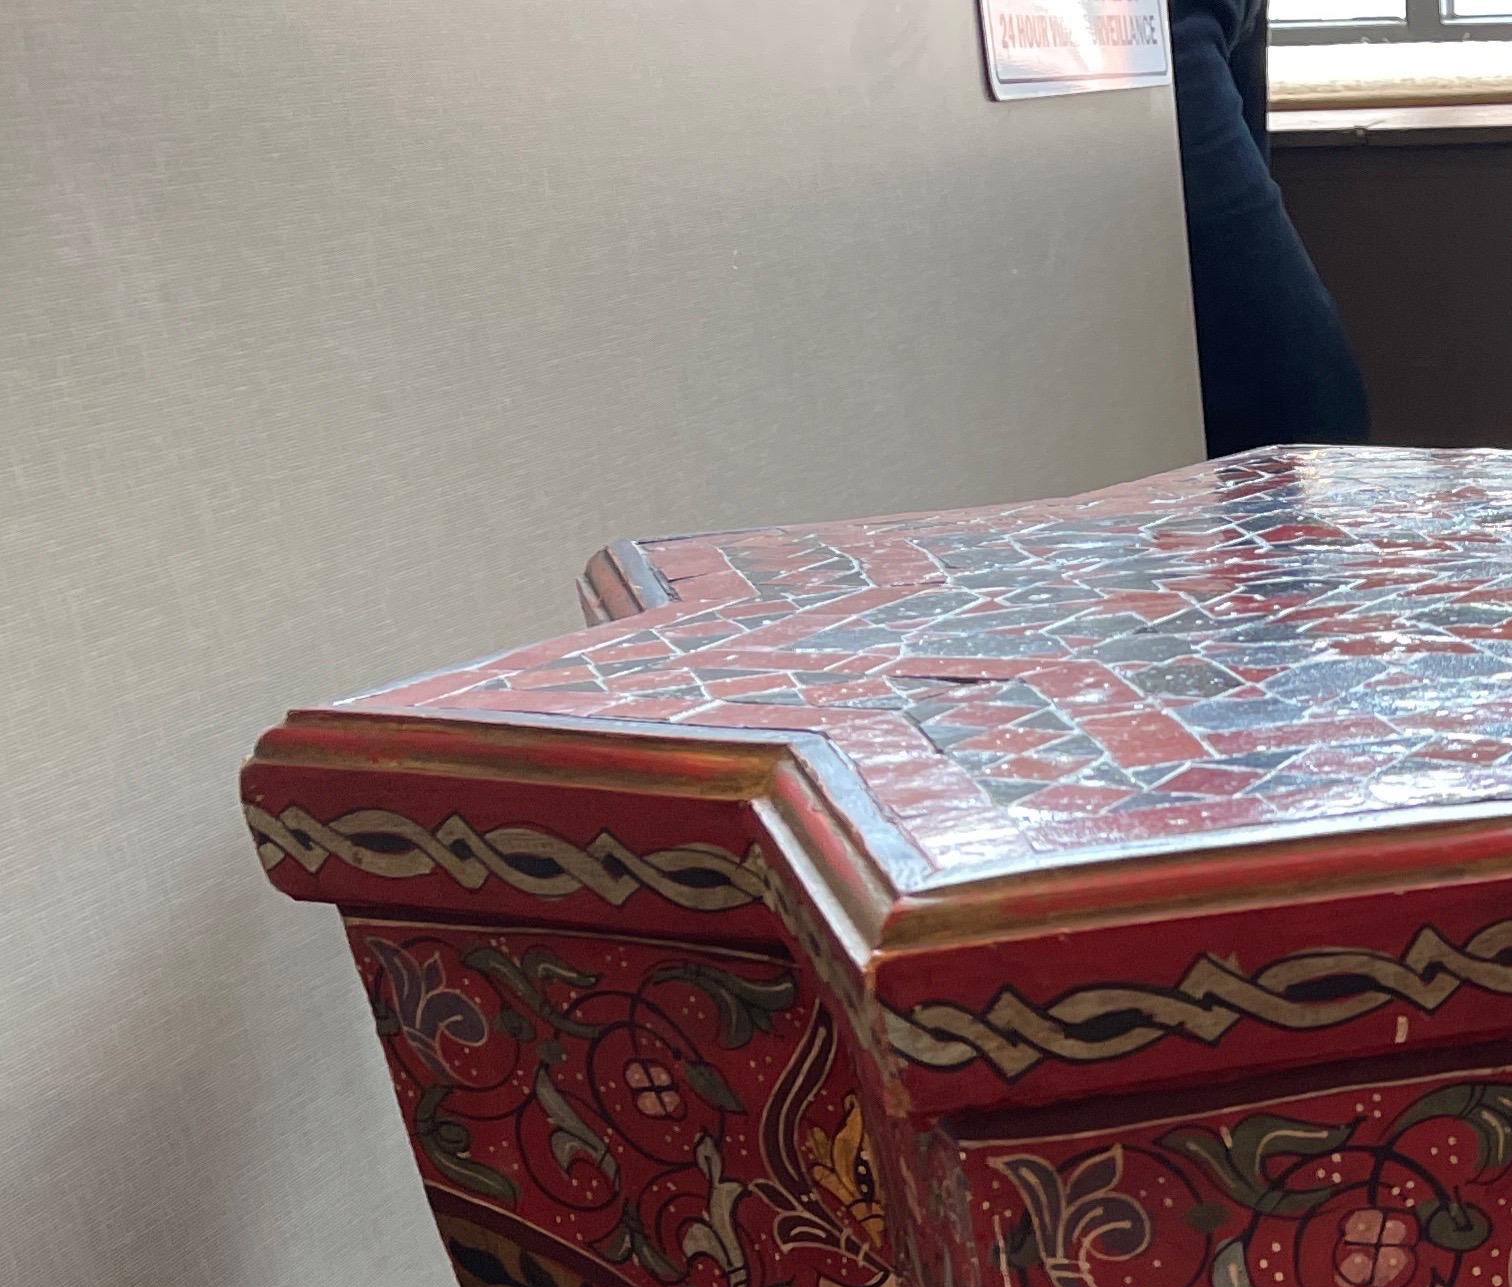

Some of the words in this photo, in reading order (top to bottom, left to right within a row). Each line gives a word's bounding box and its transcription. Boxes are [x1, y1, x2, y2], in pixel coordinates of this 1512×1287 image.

[1000, 14, 1015, 48] 24
[1017, 15, 1049, 48] HOUR
[1049, 15, 1077, 47] VID
[1086, 14, 1158, 46] URVEILLANCE
